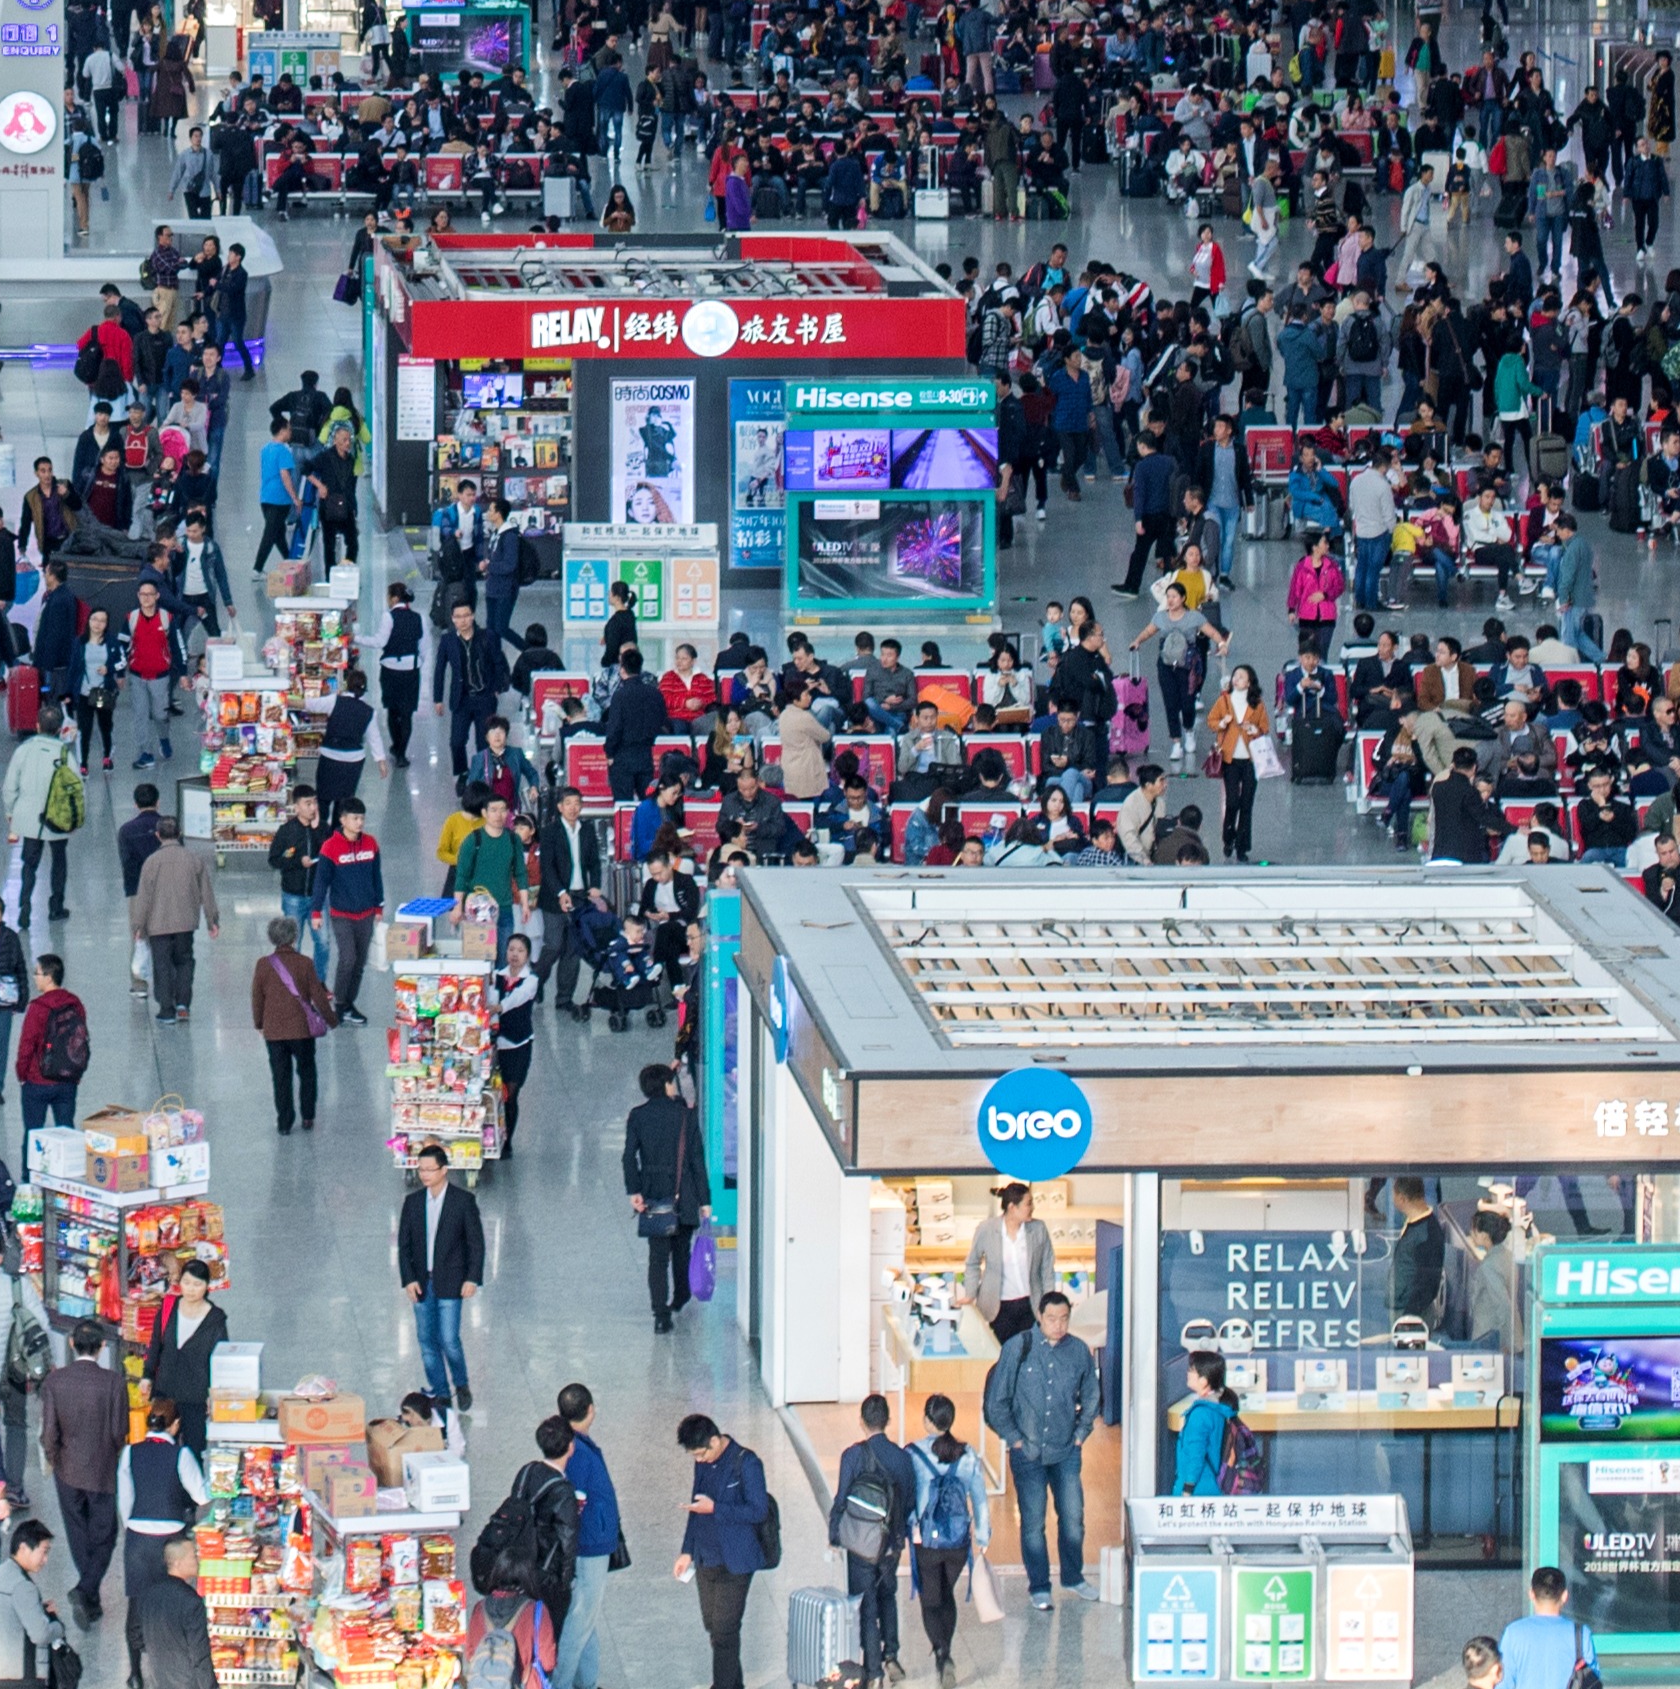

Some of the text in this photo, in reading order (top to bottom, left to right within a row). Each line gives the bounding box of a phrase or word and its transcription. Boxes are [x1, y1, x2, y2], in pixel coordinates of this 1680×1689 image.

[46, 23, 60, 43] 1
[1, 46, 62, 57] ENQUIRY
[624, 311, 847, 346] 经纬 旅友书屋
[650, 384, 690, 401] COSMO
[796, 388, 913, 408] Hisense
[939, 390, 962, 404] 8-30
[582, 527, 700, 536] 和虹桥站一起保护地球
[988, 1105, 1082, 1141] breo
[1226, 1243, 1352, 1273] RELAX
[1158, 1502, 1368, 1518] 和虹桥站一起保护地球
[1178, 1519, 1207, 1528] protect
[1208, 1519, 1221, 1528] the
[1223, 1519, 1244, 1528] earth
[1246, 1519, 1265, 1528] with
[1266, 1519, 1304, 1529] Hongqiao
[1305, 1519, 1336, 1529] Railway
[1338, 1519, 1367, 1528] Station
